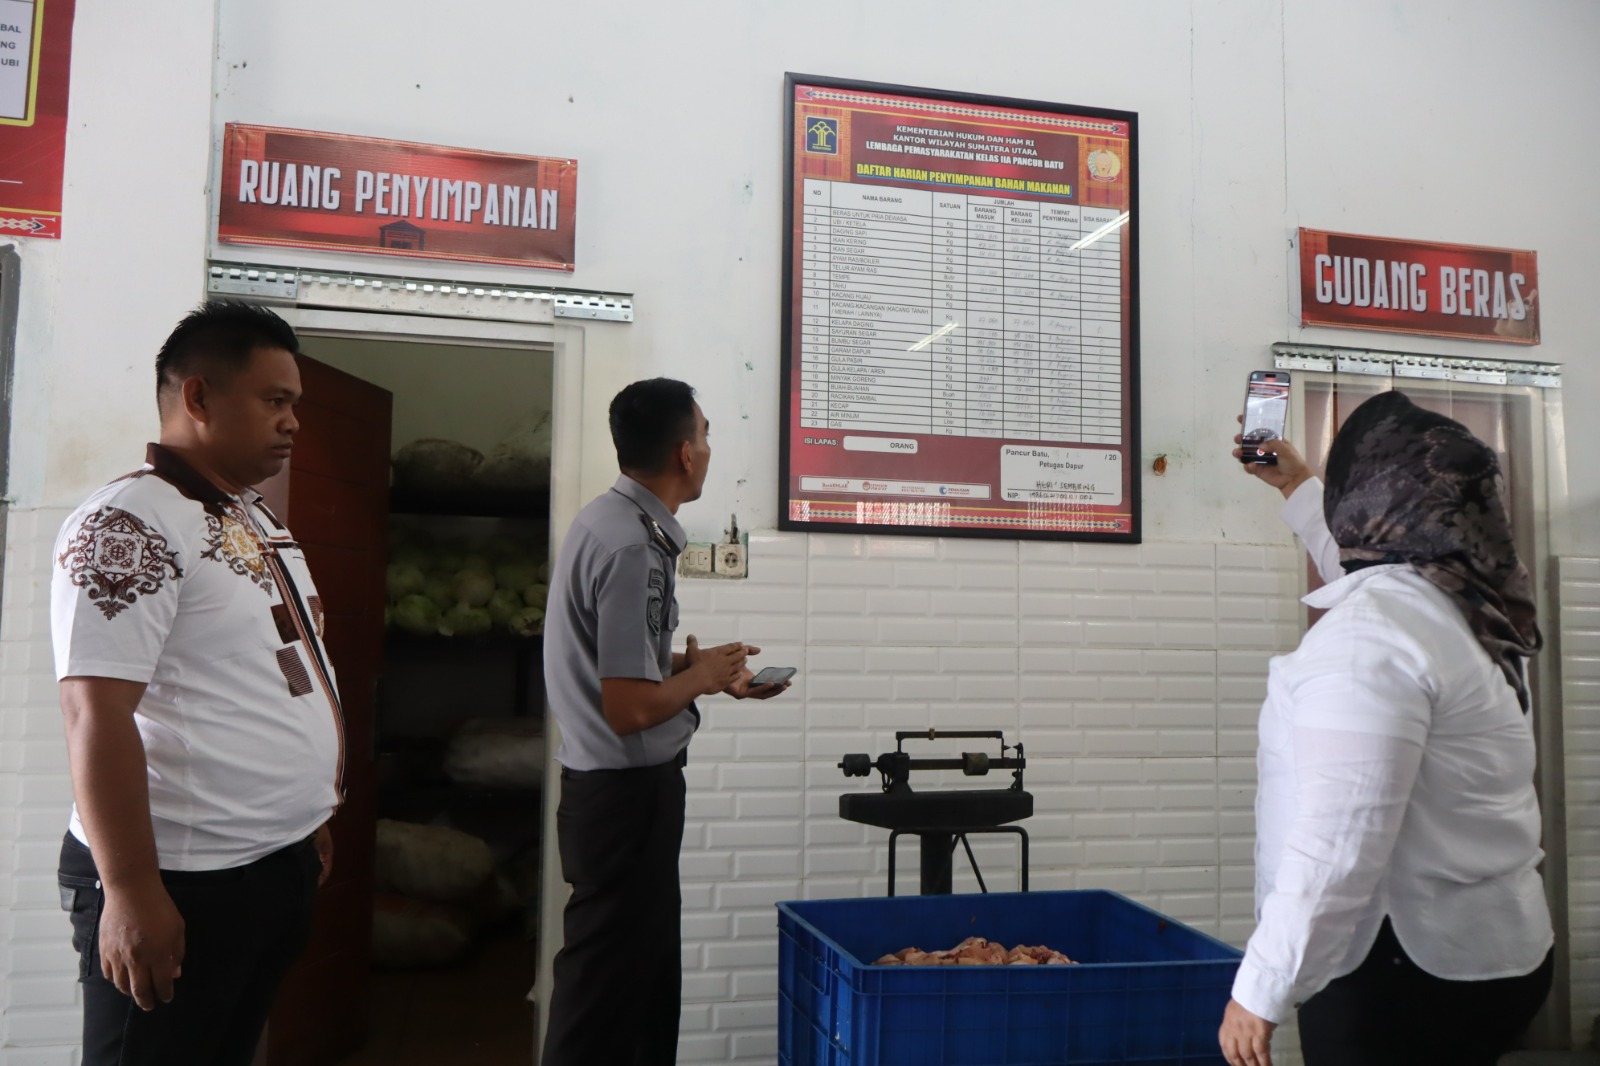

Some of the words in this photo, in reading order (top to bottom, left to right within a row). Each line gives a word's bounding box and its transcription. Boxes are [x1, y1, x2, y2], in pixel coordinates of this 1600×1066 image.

[1, 58, 19, 67] UBI
[893, 135, 926, 144] KANTOR
[928, 138, 965, 148] WILAYAH
[968, 142, 1009, 153] SUMATERA
[1012, 147, 1037, 156] UTARA
[896, 125, 954, 138] KEMENTERIAN
[956, 132, 984, 141] HUKUM
[866, 141, 903, 152] LEMBAGA
[904, 144, 974, 160] PEMASYARAKATAN
[976, 152, 998, 162] KELAS
[1000, 154, 1011, 164] IIA
[1013, 156, 1043, 167] PANCUR
[1044, 159, 1064, 169] BATU
[857, 163, 891, 177] DAFTAR
[894, 168, 927, 180] HARIAN
[929, 171, 992, 187] PENYIMPANAN
[995, 178, 1024, 191] BAHAN
[1026, 182, 1070, 194] MAKANAN
[238, 159, 341, 211] RUANG
[355, 170, 559, 231] PENYIMPANAN
[1315, 254, 1427, 312] GUDANG
[1441, 266, 1527, 320] BERAS
